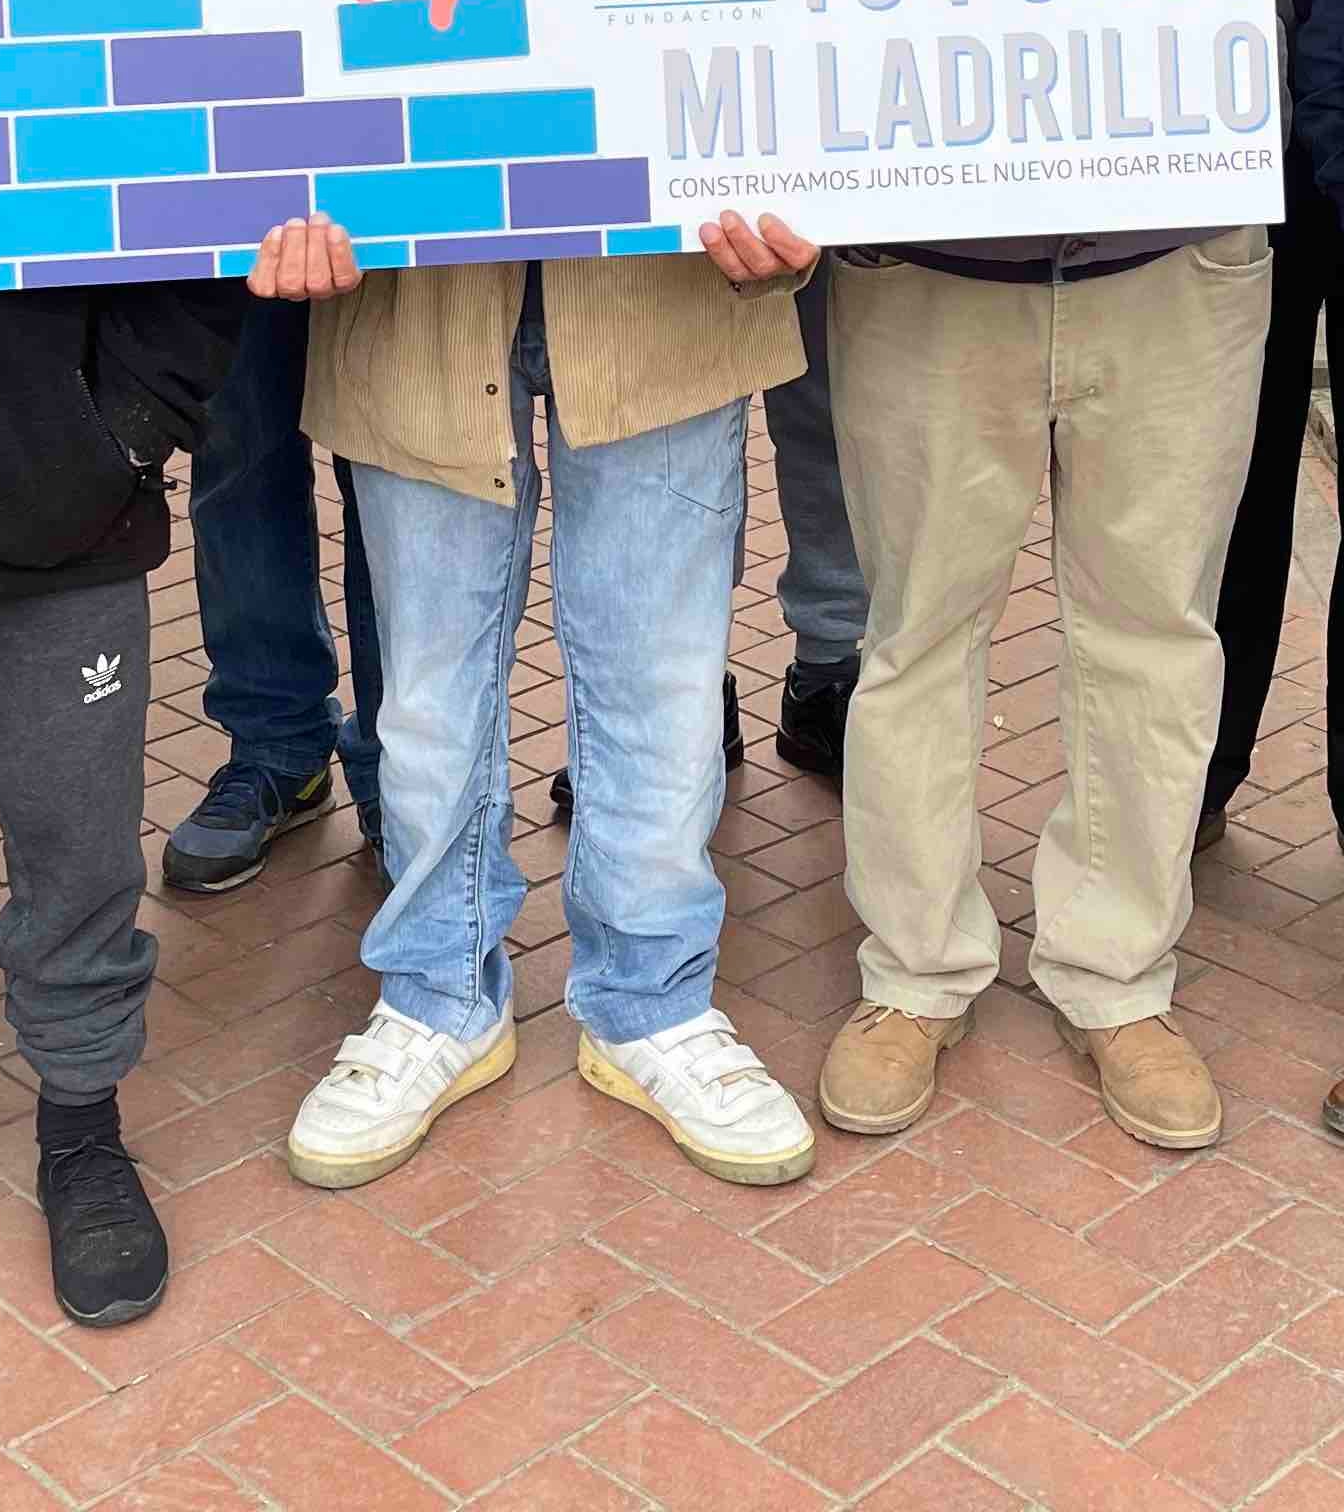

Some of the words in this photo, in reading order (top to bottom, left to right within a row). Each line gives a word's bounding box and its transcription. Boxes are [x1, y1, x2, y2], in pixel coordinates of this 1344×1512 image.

[608, 7, 762, 26] FUNDACIÓN
[663, 45, 777, 161] MI
[816, 20, 1271, 152] LADRILLO
[668, 169, 860, 199] CONSTRUYAMOS
[865, 165, 955, 190] JUNTOS
[961, 163, 987, 185] EL
[993, 159, 1073, 183] NUEVO
[1080, 155, 1161, 178] HOGAR
[1167, 149, 1274, 174] RENACER
